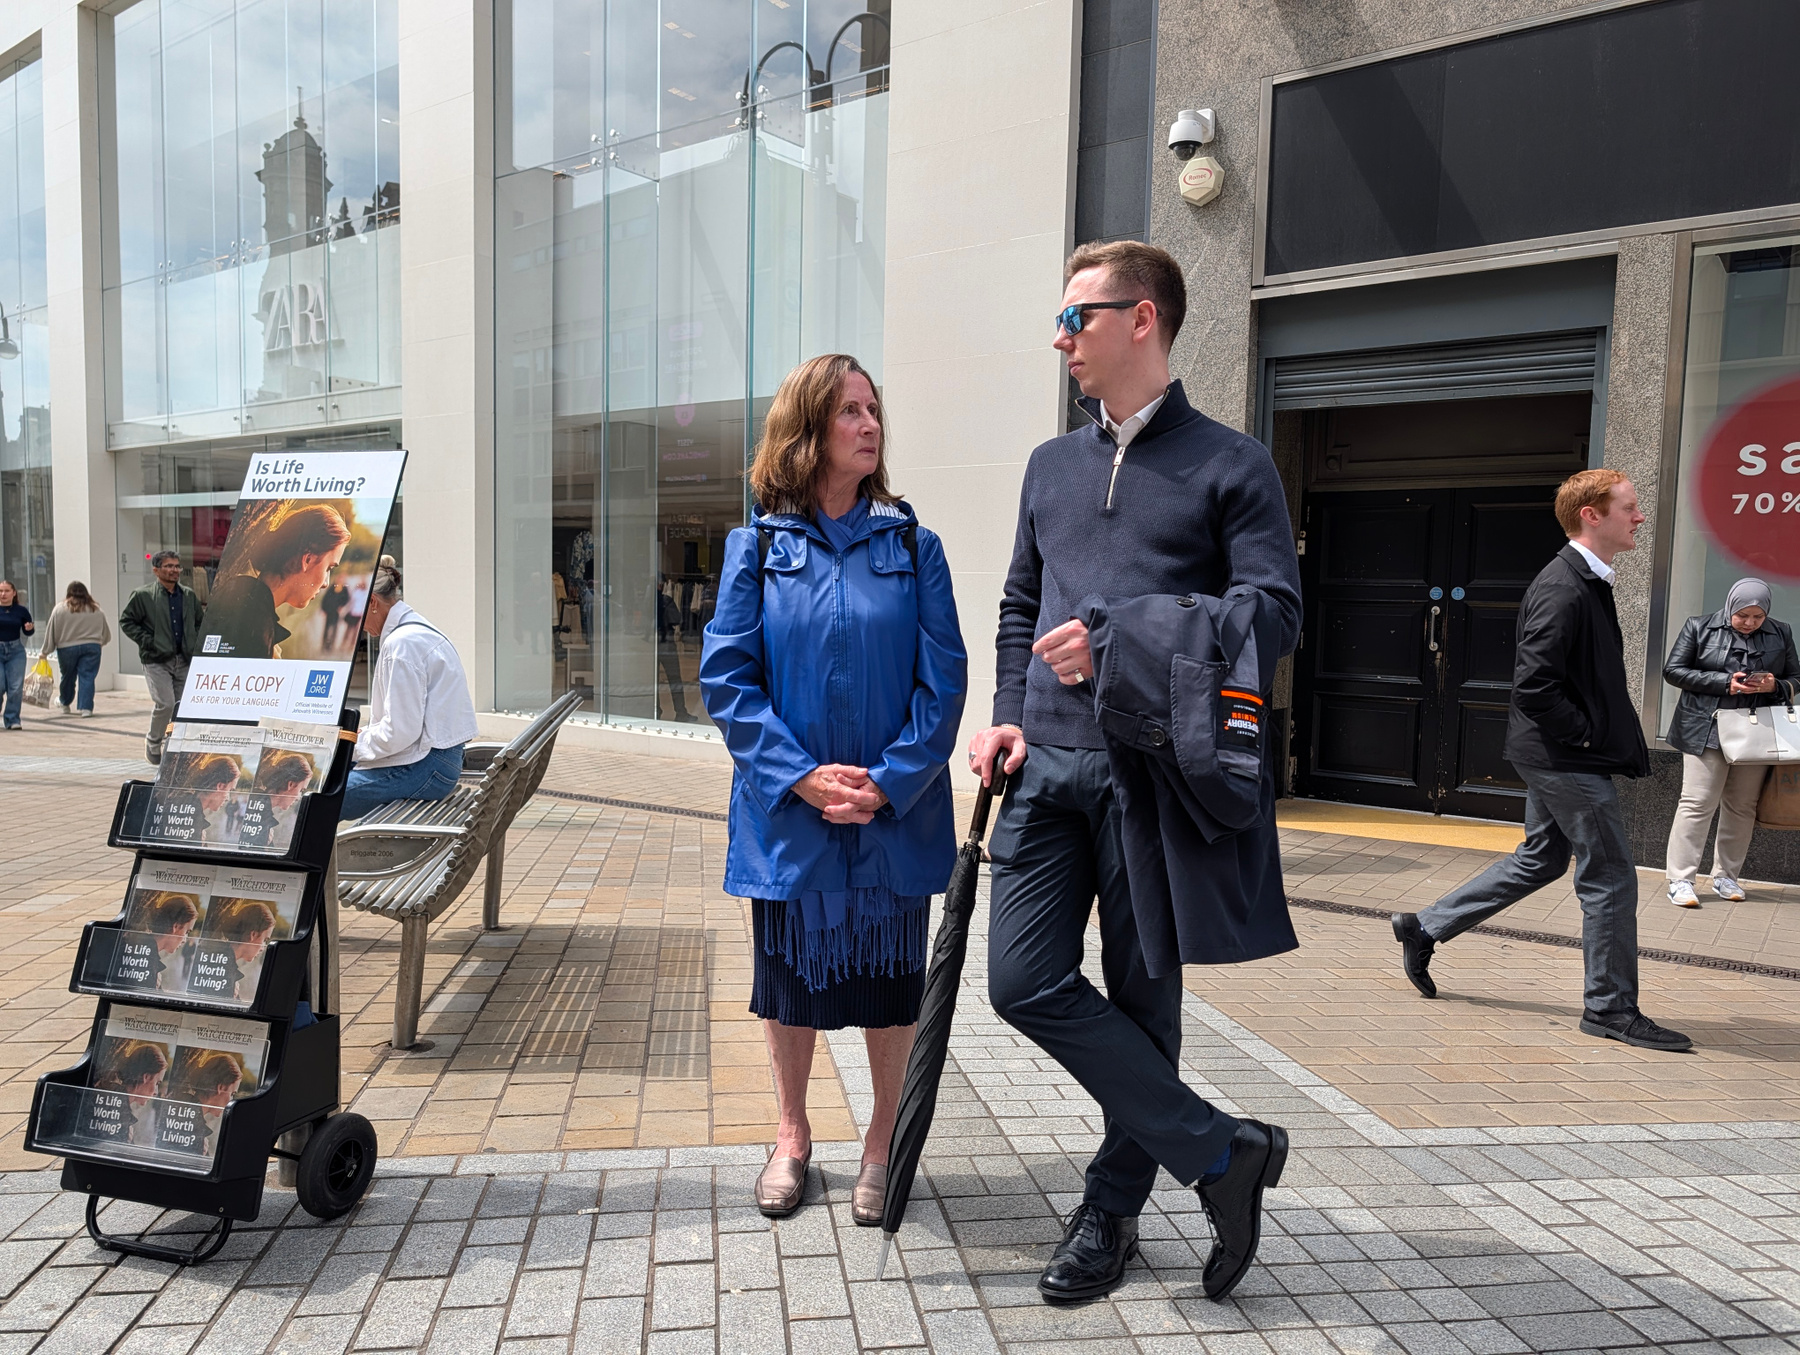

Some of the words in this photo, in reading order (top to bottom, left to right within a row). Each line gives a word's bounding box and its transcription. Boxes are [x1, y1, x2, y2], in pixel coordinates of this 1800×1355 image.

[261, 281, 330, 352] ZARA
[255, 460, 269, 474] Is
[273, 459, 304, 475] Life
[251, 477, 301, 493] Worth
[304, 477, 366, 495] Living?
[1731, 492, 1800, 514] 70%
[195, 674, 229, 691] TAKE
[231, 675, 241, 691] A
[245, 676, 285, 693] COPY
[311, 674, 329, 685] JW
[308, 686, 327, 694] .ORG
[190, 696, 204, 704] ASK
[206, 696, 219, 704] FOR
[222, 697, 240, 705] YOUR
[242, 698, 280, 707] LANGUAGE
[272, 729, 324, 745] WATCHTOWER
[155, 804, 164, 813] Is
[170, 804, 178, 813] Is
[179, 804, 196, 814] Life
[248, 800, 265, 811] Life
[167, 815, 194, 826] Worth
[244, 812, 262, 823] orth
[164, 826, 195, 839] Living?
[242, 823, 263, 836] ing?
[155, 870, 210, 885] WATCHTOWER
[231, 877, 286, 892] WATCHTOWER
[124, 944, 133, 954] Is
[134, 945, 151, 956] Life
[122, 956, 149, 968] Worth
[200, 952, 209, 962] Is
[210, 953, 228, 965] Life
[117, 967, 150, 981] Living?
[197, 964, 226, 977] Worth
[193, 976, 227, 991] Living?
[124, 1017, 179, 1033] WATCHTOWER
[197, 1026, 253, 1043] WATCHTOWER
[95, 1094, 104, 1105] Is
[105, 1095, 122, 1108] Life
[93, 1107, 120, 1120] Worth
[167, 1105, 177, 1116] Is
[178, 1106, 196, 1119] Life
[89, 1119, 122, 1135] Living?
[165, 1118, 194, 1132] Worth
[162, 1131, 196, 1146] Living?
